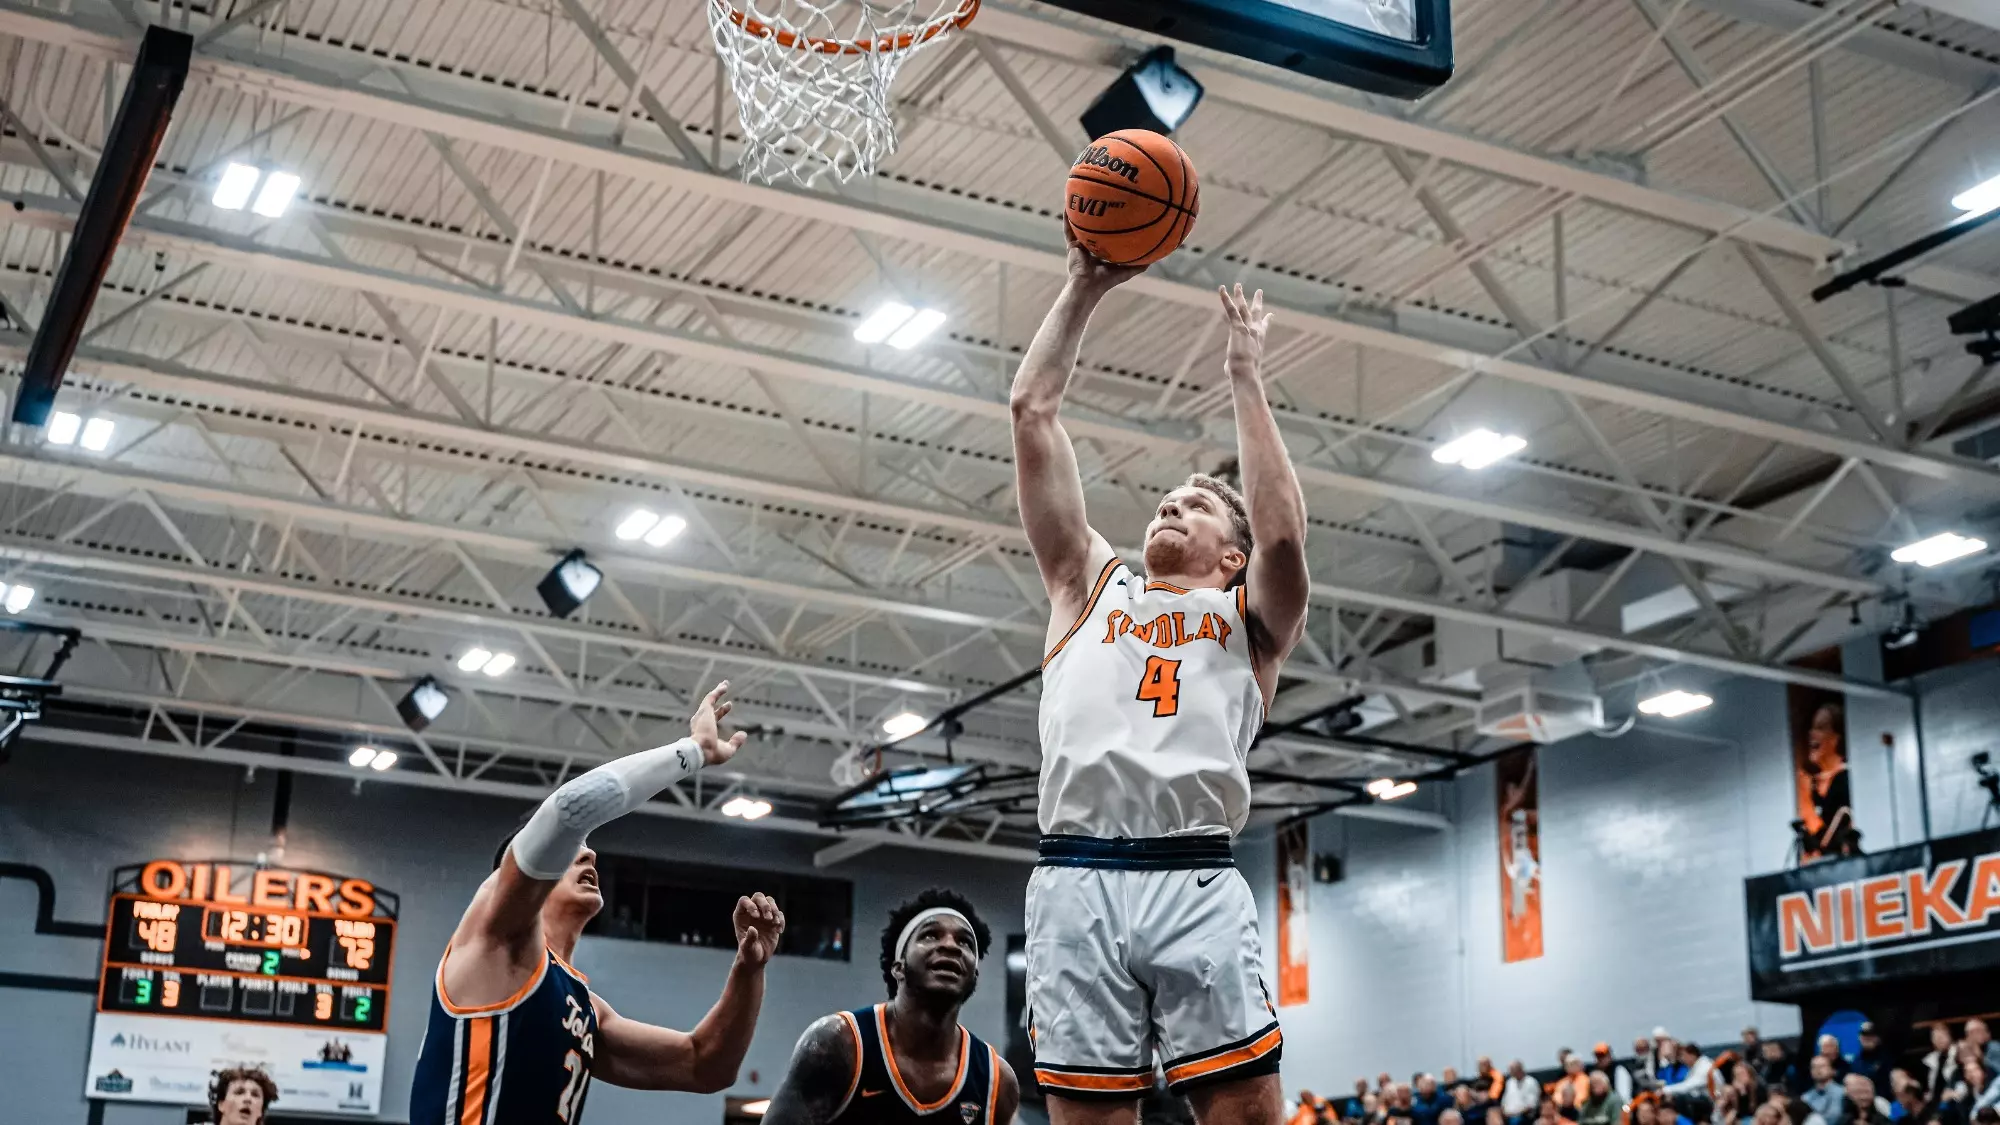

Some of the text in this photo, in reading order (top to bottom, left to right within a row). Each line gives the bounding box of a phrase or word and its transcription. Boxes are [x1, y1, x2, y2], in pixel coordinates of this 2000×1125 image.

[1070, 194, 1107, 217] EVO
[1102, 609, 1232, 652] FINDLAY
[1135, 655, 1182, 718] 4
[141, 860, 376, 918] OILERS
[138, 920, 178, 952] 48
[220, 910, 301, 946] 12:30
[262, 950, 280, 976] 2
[338, 936, 374, 970] 72
[134, 978, 152, 1005] 3
[161, 979, 180, 1008] 3
[314, 992, 334, 1020] 3
[354, 994, 372, 1022] 2
[129, 1033, 191, 1053] HYLANT
